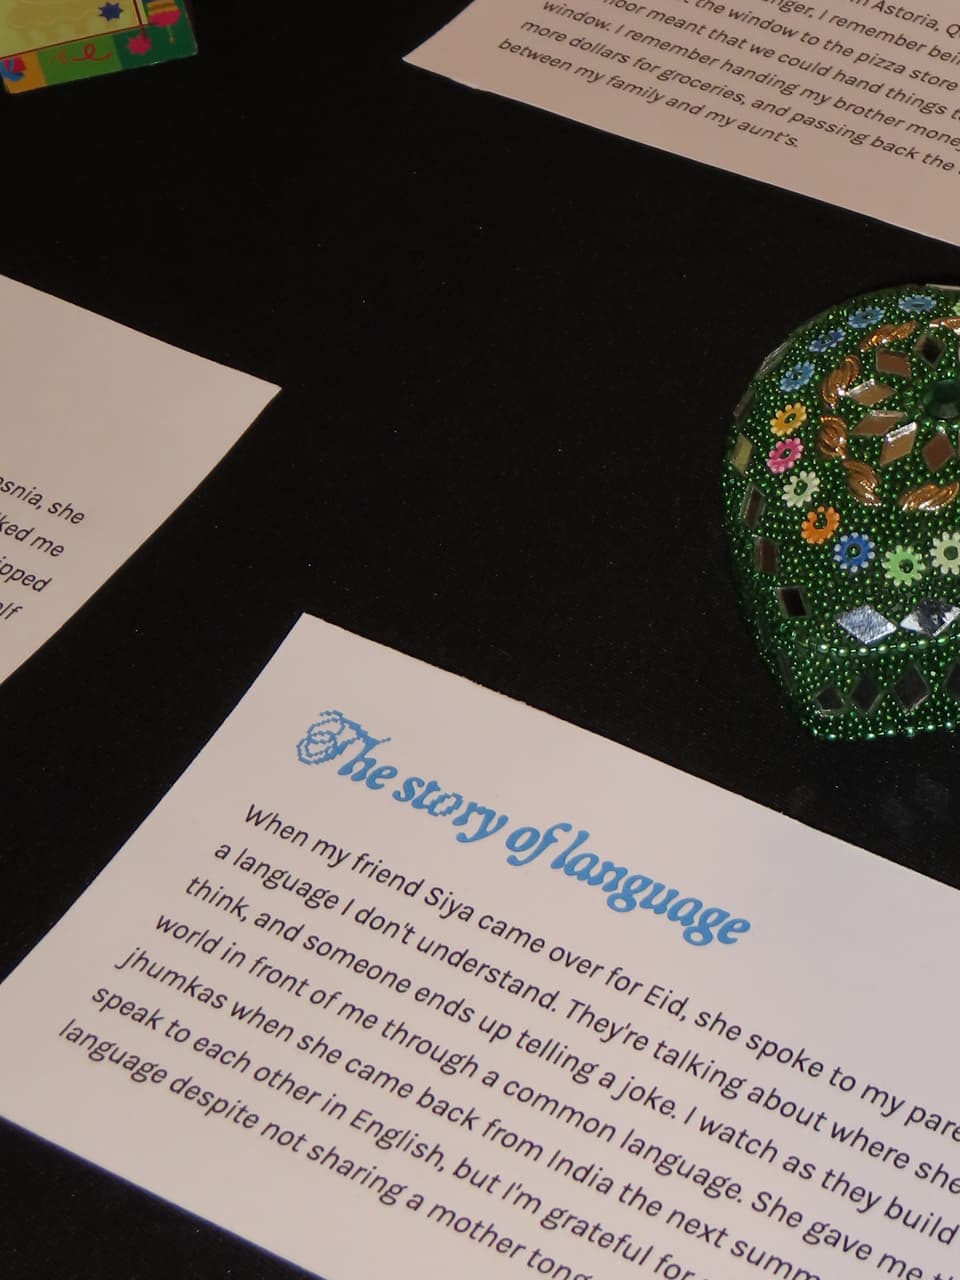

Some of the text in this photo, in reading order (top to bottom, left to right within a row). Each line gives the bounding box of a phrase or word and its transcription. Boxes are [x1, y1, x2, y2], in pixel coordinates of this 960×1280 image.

[817, 8, 829, 21] I
[827, 15, 928, 53] remember
[870, 0, 940, 32] Astoria,
[47, 503, 86, 525] she
[30, 536, 65, 558] me
[295, 709, 752, 947] The story of language
[244, 803, 309, 848] When
[310, 838, 352, 869] my
[350, 852, 426, 898] friend
[423, 886, 475, 923] Siya
[477, 914, 546, 954] came
[548, 946, 605, 979] over
[604, 966, 644, 996] for
[643, 984, 690, 1022] Eid,
[694, 1011, 742, 1042] she
[745, 1033, 825, 1078] spoke
[828, 1066, 857, 1092] to
[860, 1084, 906, 1119] my
